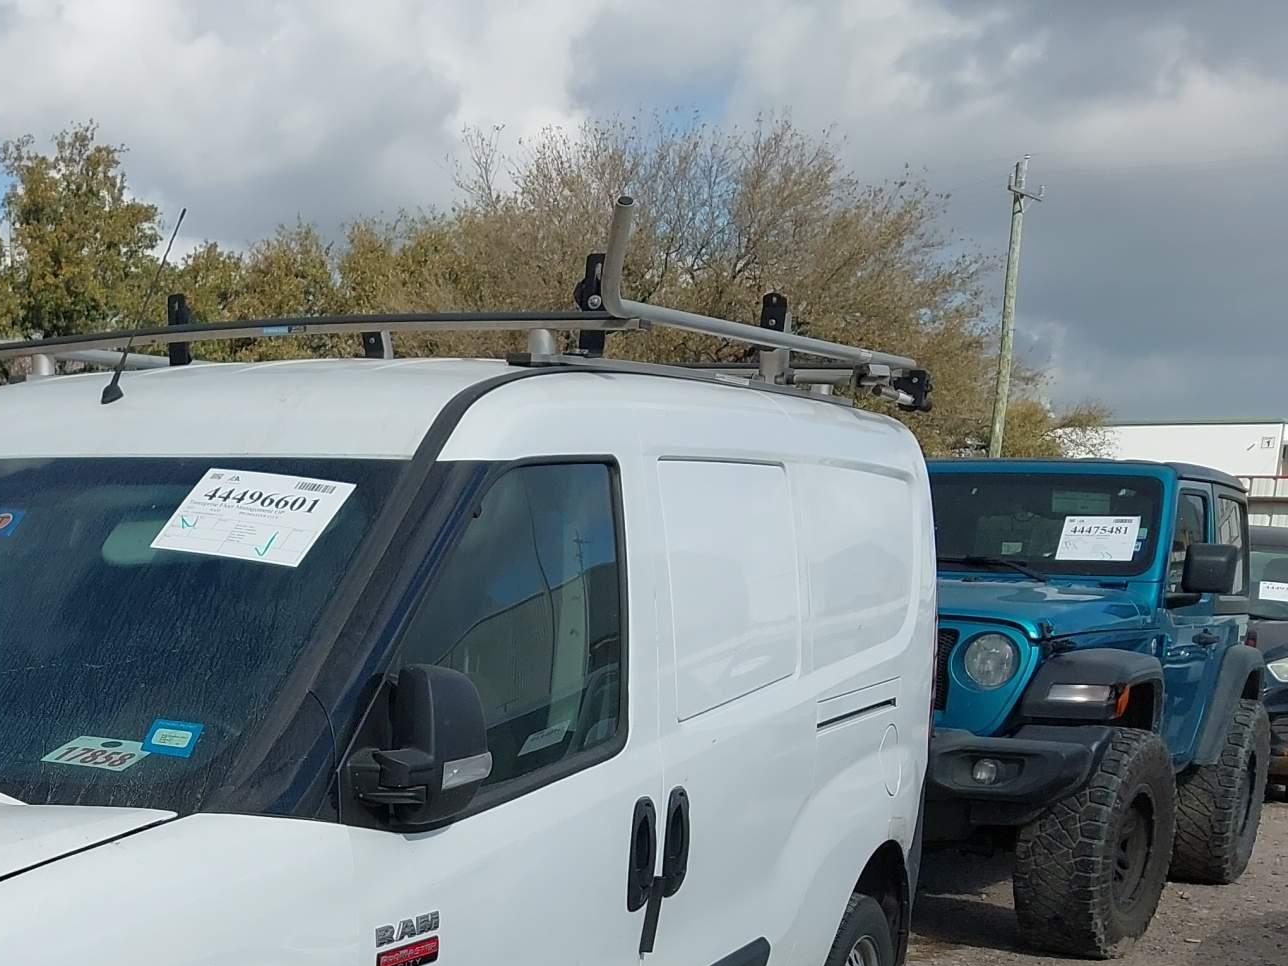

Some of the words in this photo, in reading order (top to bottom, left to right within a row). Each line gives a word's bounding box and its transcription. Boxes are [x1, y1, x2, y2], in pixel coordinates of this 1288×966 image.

[204, 486, 321, 514] 44496601
[1070, 525, 1129, 536] 44475481
[54, 746, 136, 767] 17858
[375, 910, 440, 948] RAM
